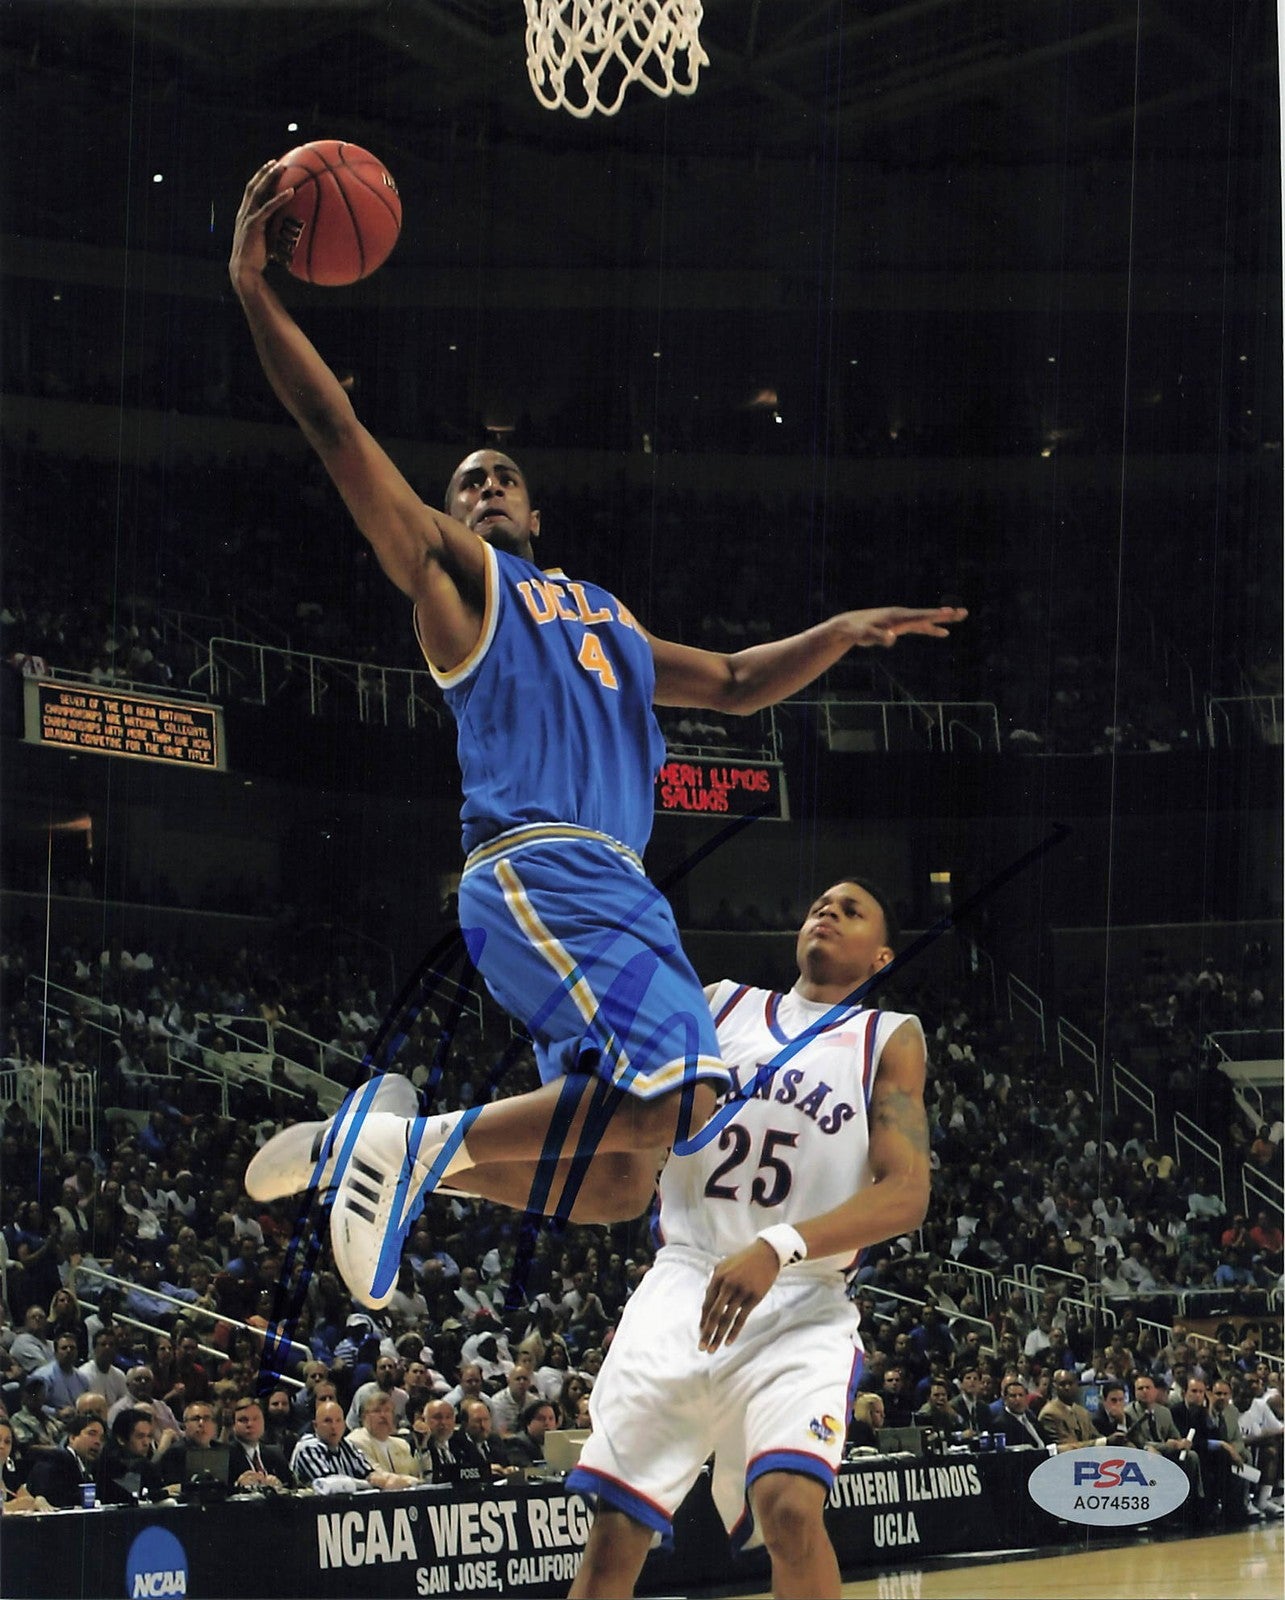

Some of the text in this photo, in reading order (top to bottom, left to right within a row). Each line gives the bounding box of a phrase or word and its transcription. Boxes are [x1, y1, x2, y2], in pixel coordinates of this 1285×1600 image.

[578, 632, 619, 690] 4
[710, 1062, 856, 1135] ANSAS
[704, 1123, 800, 1208] 25
[825, 1464, 982, 1509] UTHERN ILLINOIS
[427, 1500, 518, 1558] WEST
[873, 1511, 921, 1548] UCLA
[132, 1570, 186, 1599] NCAA
[416, 1565, 450, 1596] SAN
[454, 1560, 502, 1592] JOSE,
